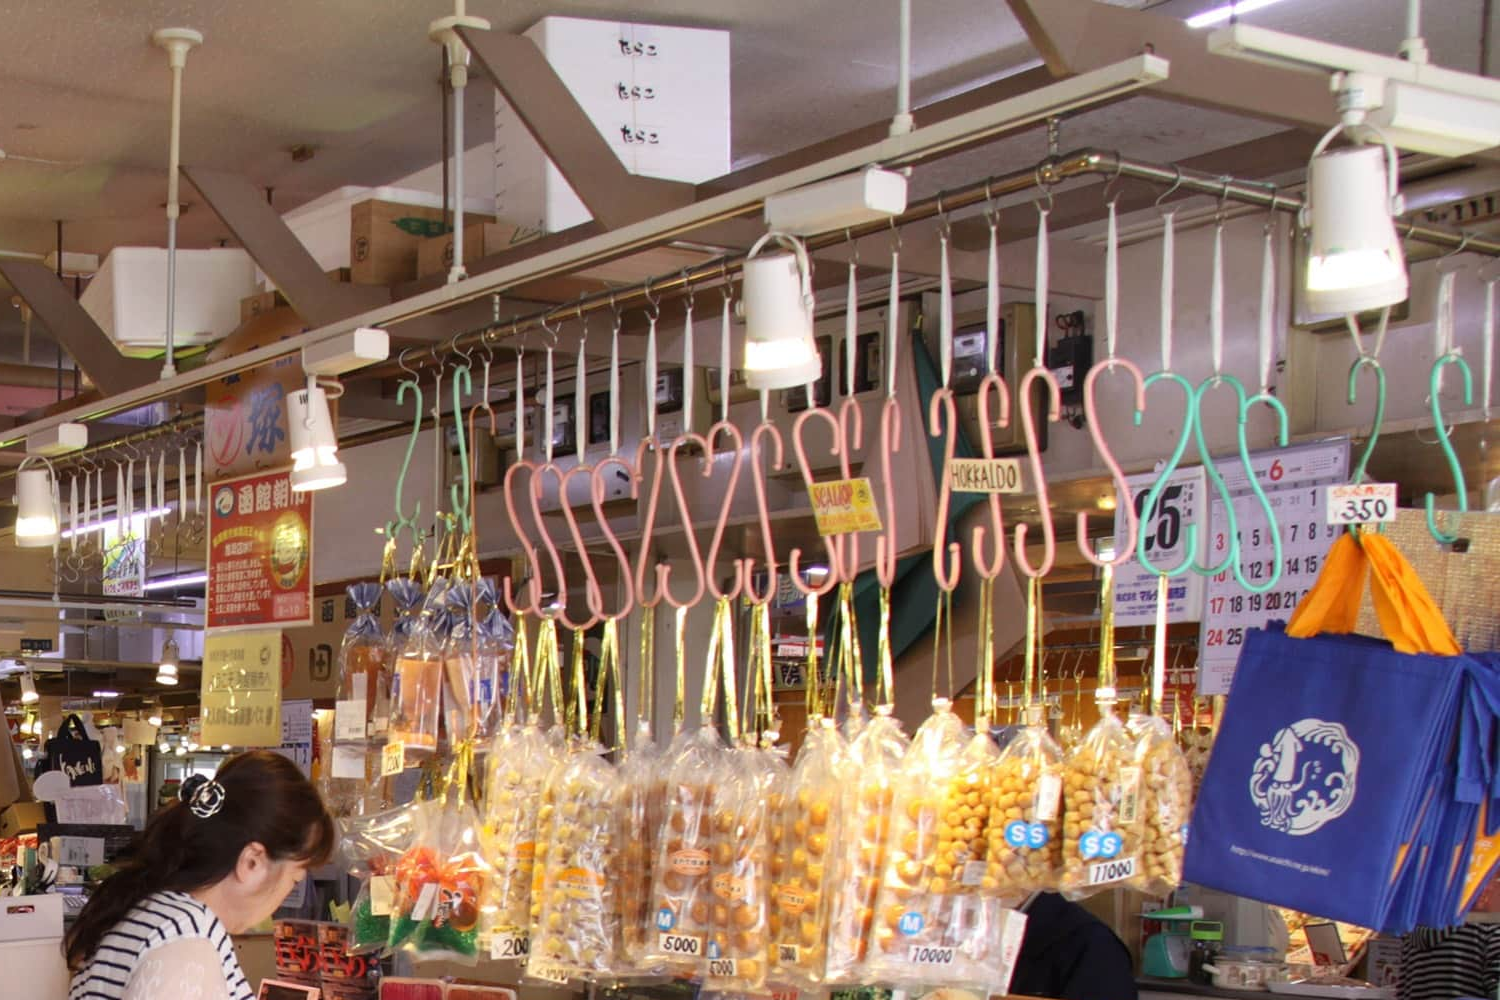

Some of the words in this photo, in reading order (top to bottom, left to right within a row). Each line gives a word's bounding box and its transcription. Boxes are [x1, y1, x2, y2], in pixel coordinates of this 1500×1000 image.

[618, 37, 658, 57] たらこ
[616, 82, 656, 101] たらこ
[620, 125, 660, 144] たらこ
[950, 463, 1017, 491] HOKKAIDO
[1268, 459, 1284, 481] 6
[1310, 489, 1317, 508] 1
[1340, 499, 1388, 521] 350
[1215, 533, 1225, 551] 3
[1251, 530, 1261, 547] 5
[1290, 525, 1298, 542] 7
[1308, 521, 1317, 541] 8
[1250, 563, 1263, 580] 12
[1286, 557, 1300, 575] 14
[1304, 554, 1318, 573] 15
[1209, 597, 1225, 616] 17
[1229, 596, 1244, 614] 18
[1248, 593, 1263, 612] 19
[1264, 591, 1282, 611] 20
[1282, 590, 1298, 609] 21
[1206, 628, 1223, 647] 24
[1227, 627, 1243, 647] 25
[1093, 862, 1133, 882] 11000
[659, 910, 674, 926] M
[904, 914, 920, 931] M
[663, 936, 698, 954] 5000
[912, 945, 953, 963] 10000
